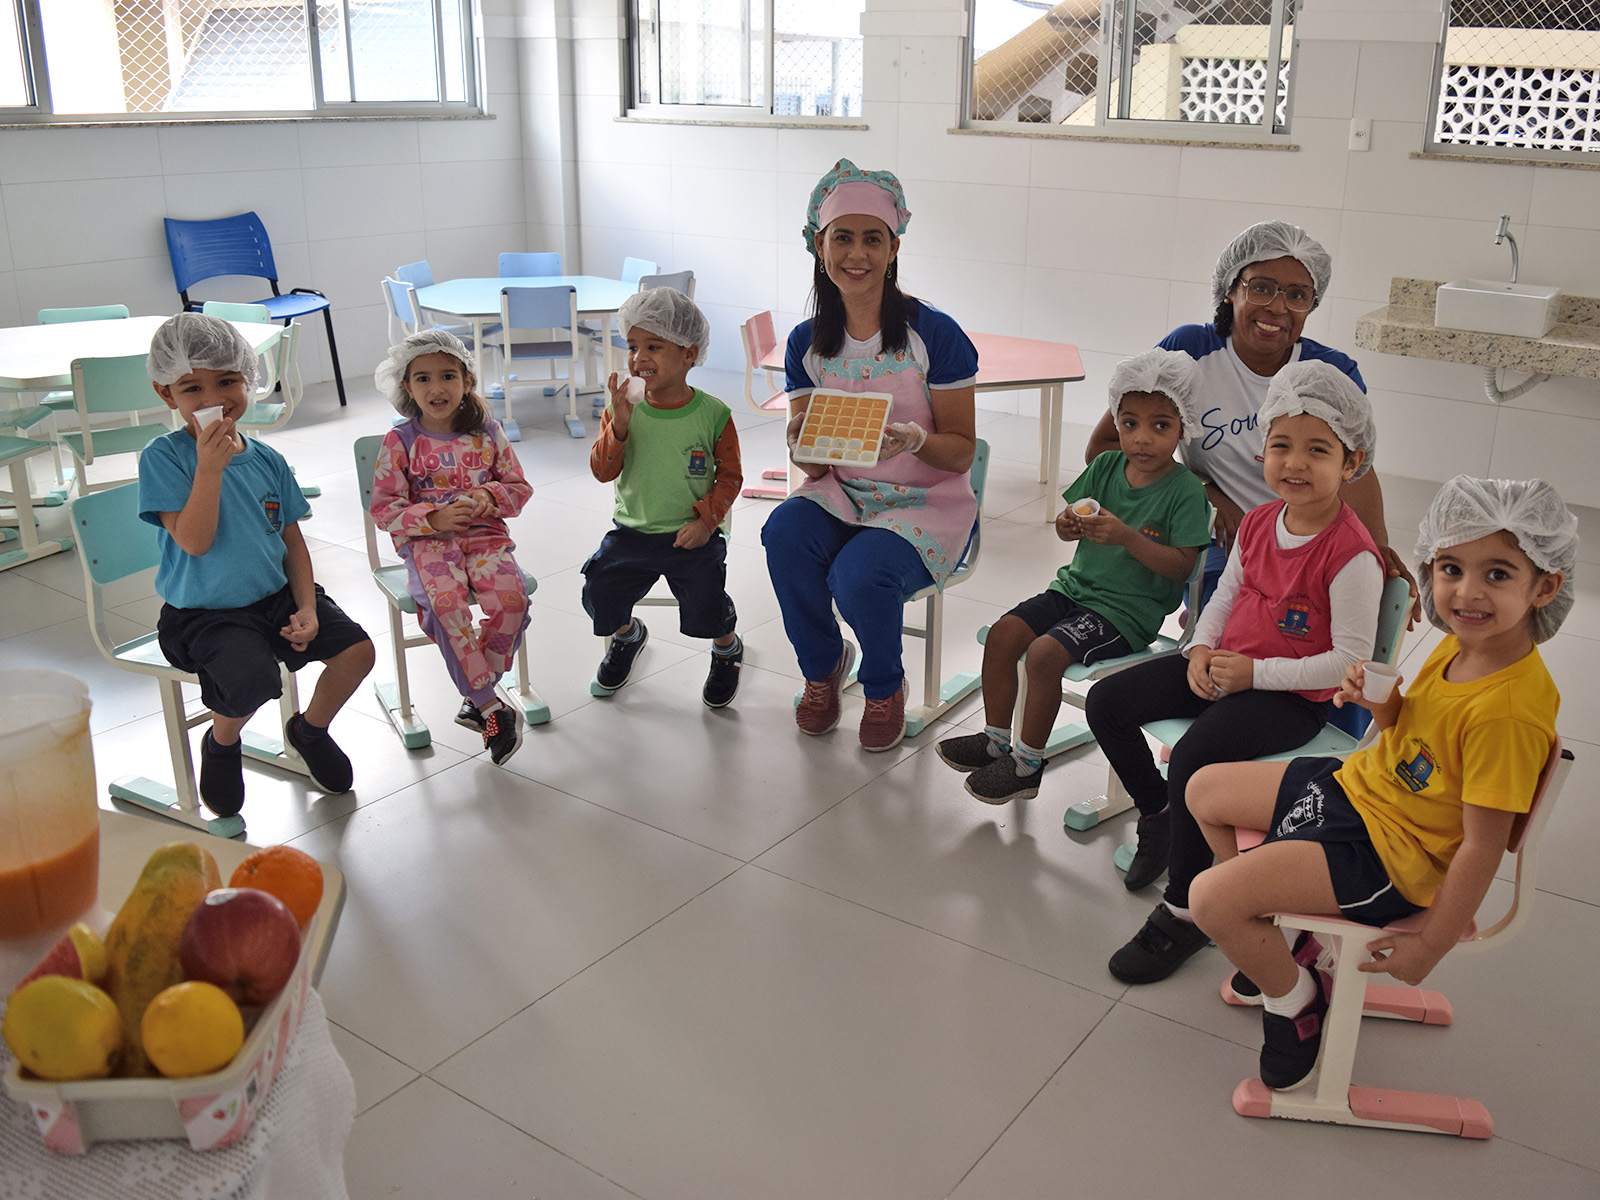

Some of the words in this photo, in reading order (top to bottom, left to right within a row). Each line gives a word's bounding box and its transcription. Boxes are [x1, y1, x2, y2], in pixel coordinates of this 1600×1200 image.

[410, 451, 457, 480] you
[461, 447, 494, 469] are
[413, 468, 473, 494] made
